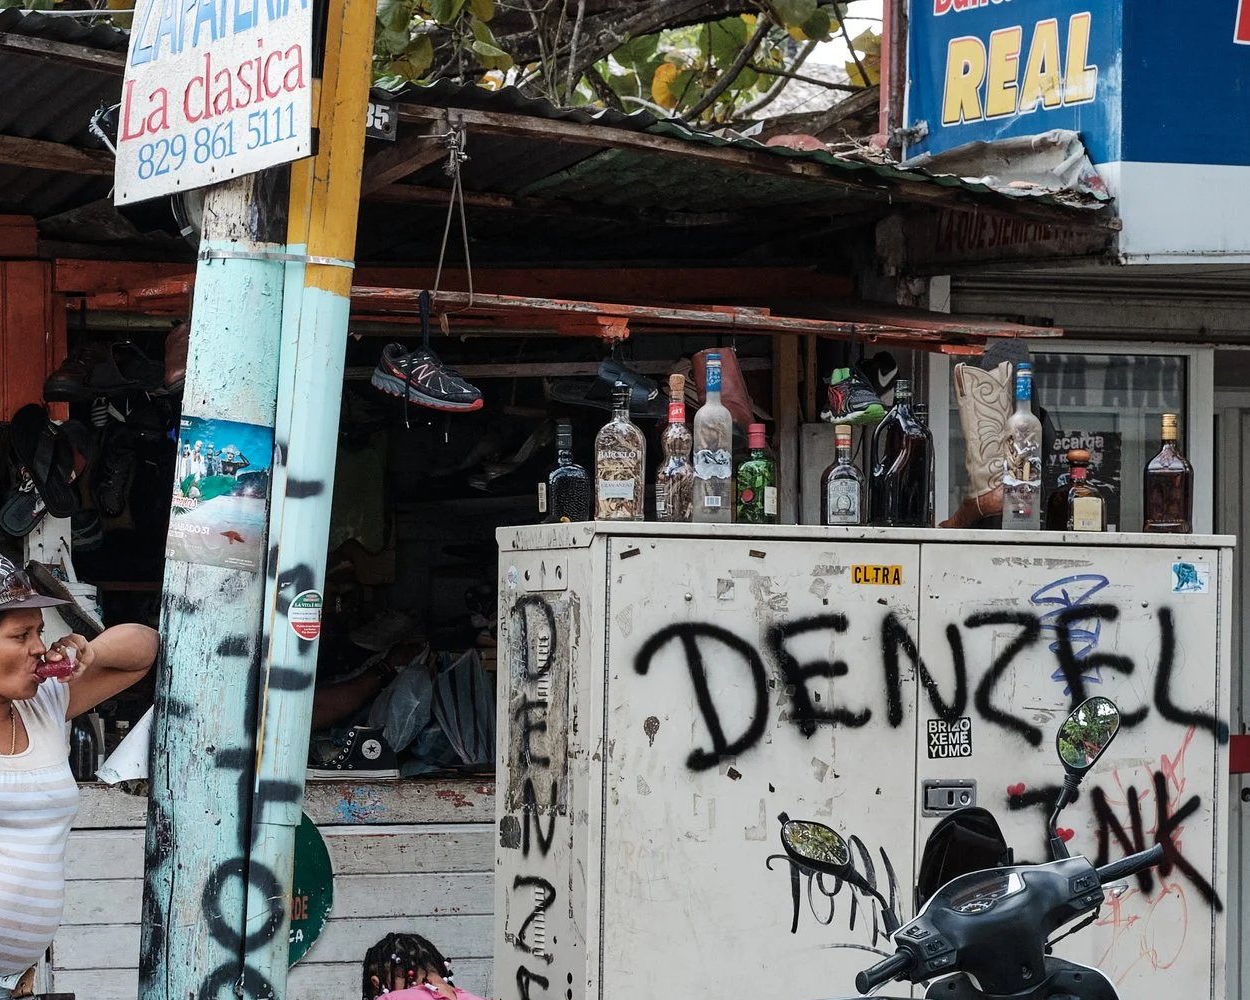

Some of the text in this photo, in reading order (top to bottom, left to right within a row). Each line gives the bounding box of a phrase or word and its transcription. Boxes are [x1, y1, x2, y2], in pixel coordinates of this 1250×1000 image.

[130, 0, 310, 67] ZAPAT
[120, 38, 306, 142] La clasica
[941, 12, 1098, 127] REAL
[138, 102, 298, 179] 829 861 5111
[1053, 435, 1104, 451] ecarga
[854, 566, 901, 585] CLTRA
[634, 604, 1229, 771] DENZEL
[929, 744, 971, 758] YUMO
[930, 731, 969, 746] XEME
